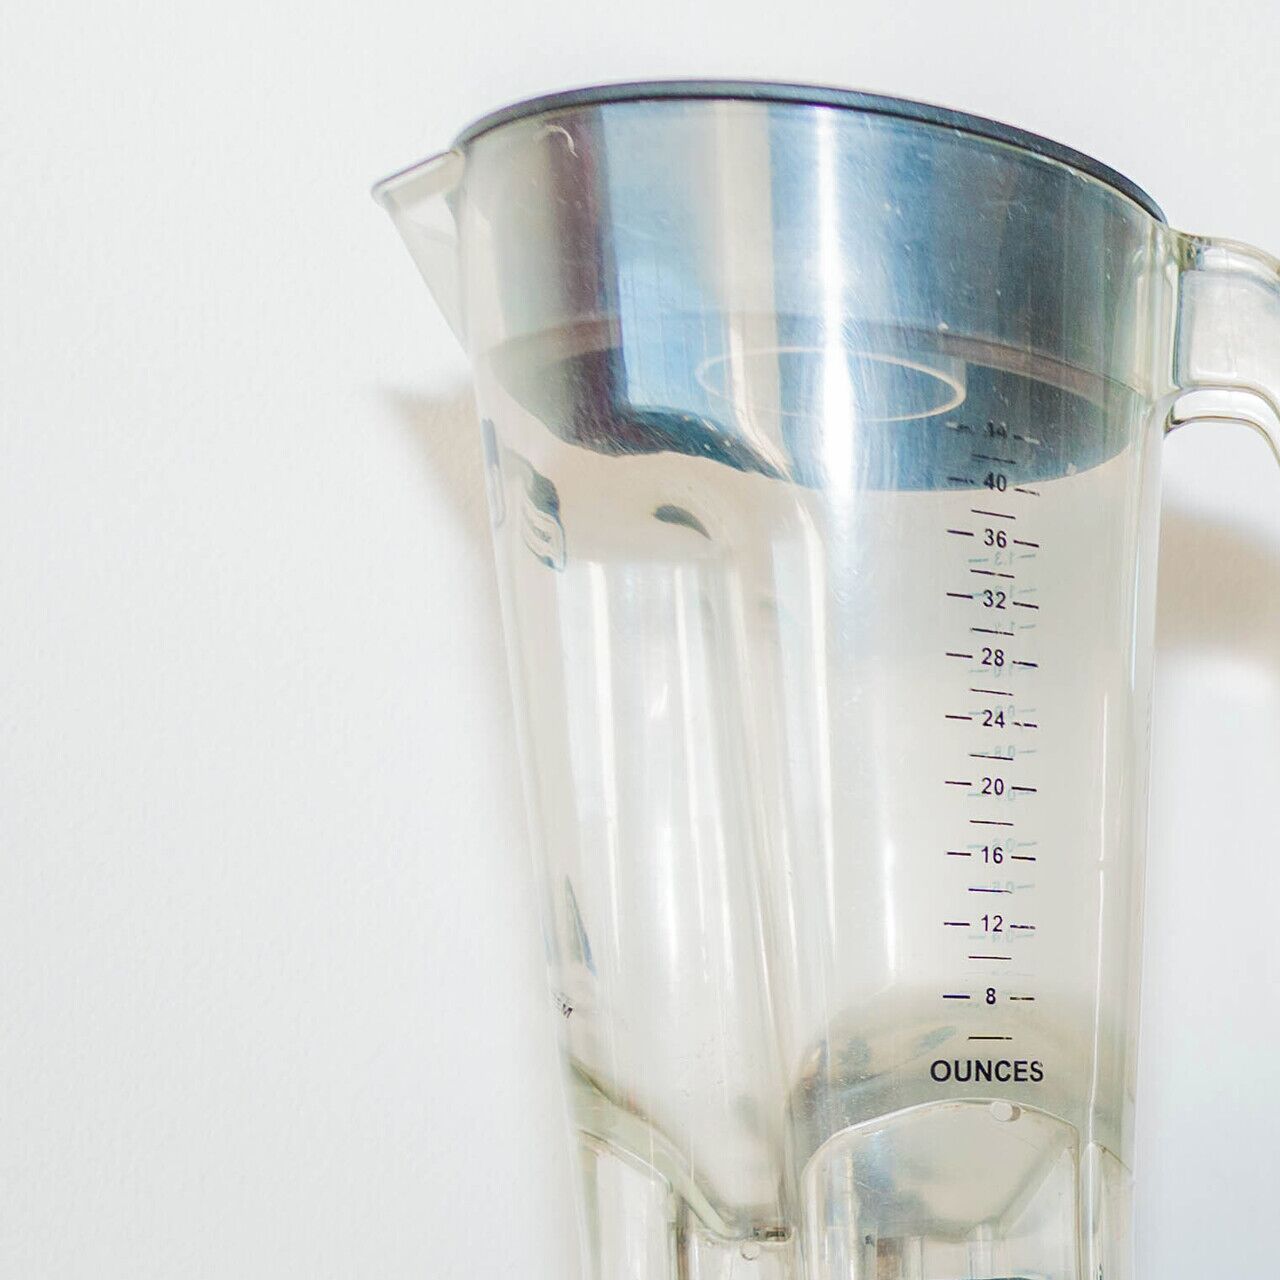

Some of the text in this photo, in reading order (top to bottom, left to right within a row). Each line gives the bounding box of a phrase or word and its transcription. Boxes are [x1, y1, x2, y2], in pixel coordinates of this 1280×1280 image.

[983, 471, 1007, 492] 40
[984, 528, 1007, 549] 36
[983, 589, 1006, 610] 32
[981, 647, 1005, 667] 28
[982, 709, 1006, 728] 24
[981, 777, 1004, 796] 20
[981, 846, 1003, 864] 16
[981, 914, 1003, 933] 12
[985, 987, 996, 1005] 8
[930, 1059, 1044, 1083] OUNCES
